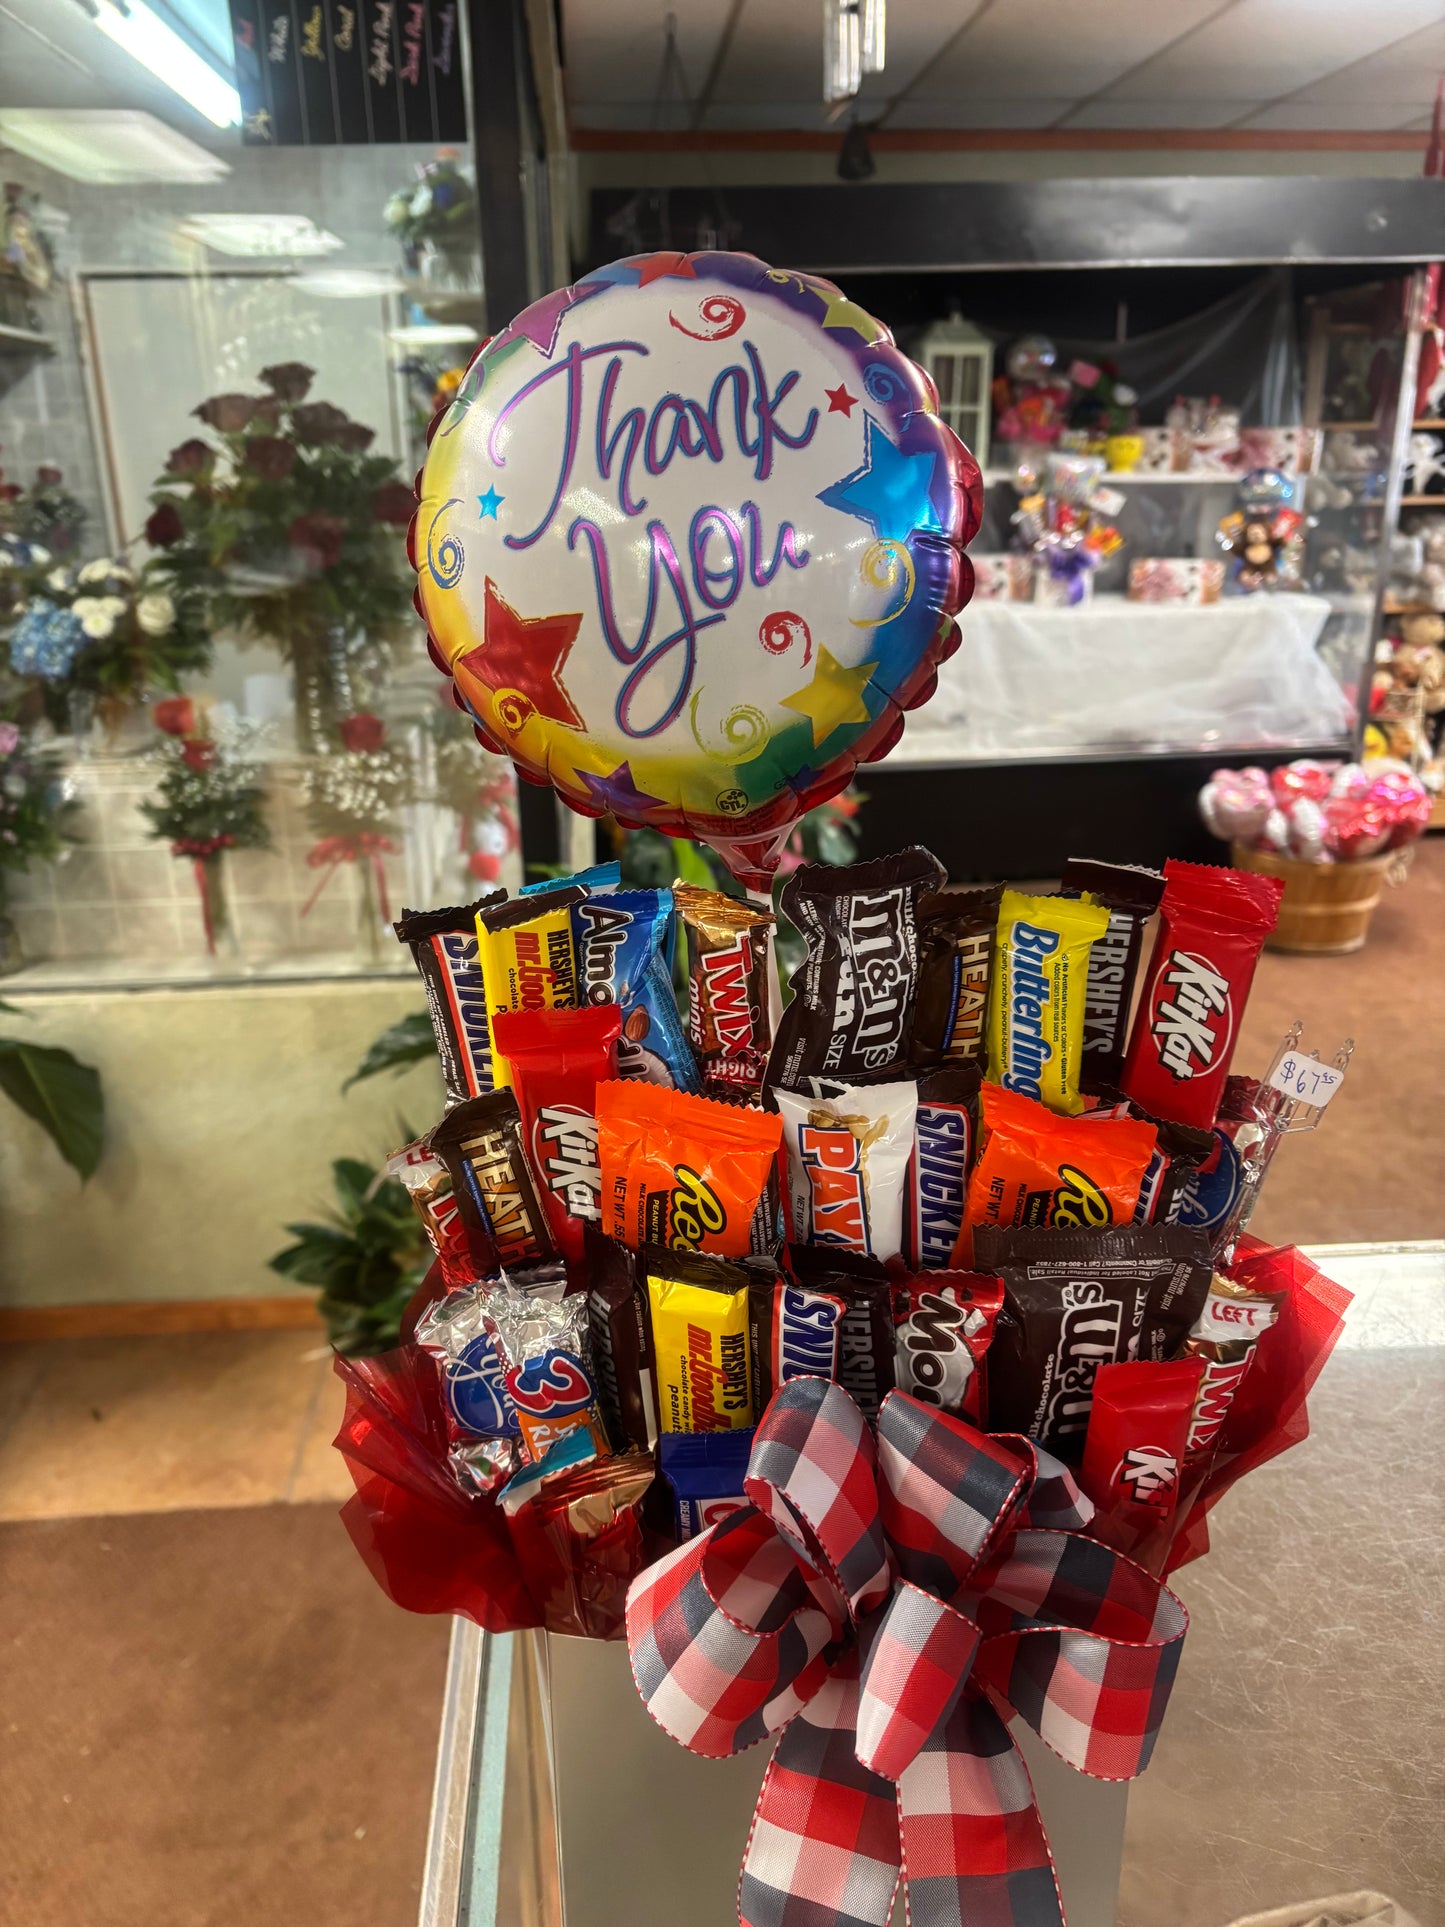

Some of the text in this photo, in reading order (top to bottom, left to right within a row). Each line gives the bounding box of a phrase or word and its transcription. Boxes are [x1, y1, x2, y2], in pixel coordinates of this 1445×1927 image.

[489, 340, 819, 550] Thank
[567, 500, 810, 739] You
[905, 887, 914, 925] milk
[514, 932, 557, 1012] mr.Goo
[547, 929, 575, 1009] HERSHEY'S
[813, 966, 821, 994] CONTAINS
[1062, 962, 1069, 971] No
[508, 968, 519, 1009] chocolate
[702, 936, 760, 1058] TWIX
[810, 995, 819, 1011] MILK
[943, 934, 991, 1060] HEATH
[440, 1018, 450, 1045] LABELED
[706, 1059, 757, 1077] RIGHT
[787, 1037, 806, 1086] visit mms.com
[823, 1034, 847, 1070] SIZE
[459, 1131, 542, 1266] HEATH
[613, 1176, 627, 1202] NET
[797, 1195, 805, 1211] NET
[986, 1176, 1006, 1220] NET WT
[1016, 1183, 1027, 1198] MILK
[614, 1203, 625, 1220] WT
[796, 1212, 804, 1225] WT
[1028, 1198, 1041, 1227] PEANUT
[1102, 1259, 1137, 1267] Comments?
[1160, 1263, 1186, 1310] visit mms.com
[1211, 1302, 1258, 1326] LEFT
[506, 1357, 591, 1413] 3
[680, 1355, 689, 1393] chocolate
[720, 1332, 748, 1410] HERSHEY'S
[1034, 1353, 1055, 1420] chocolate
[682, 1396, 691, 1420] candy
